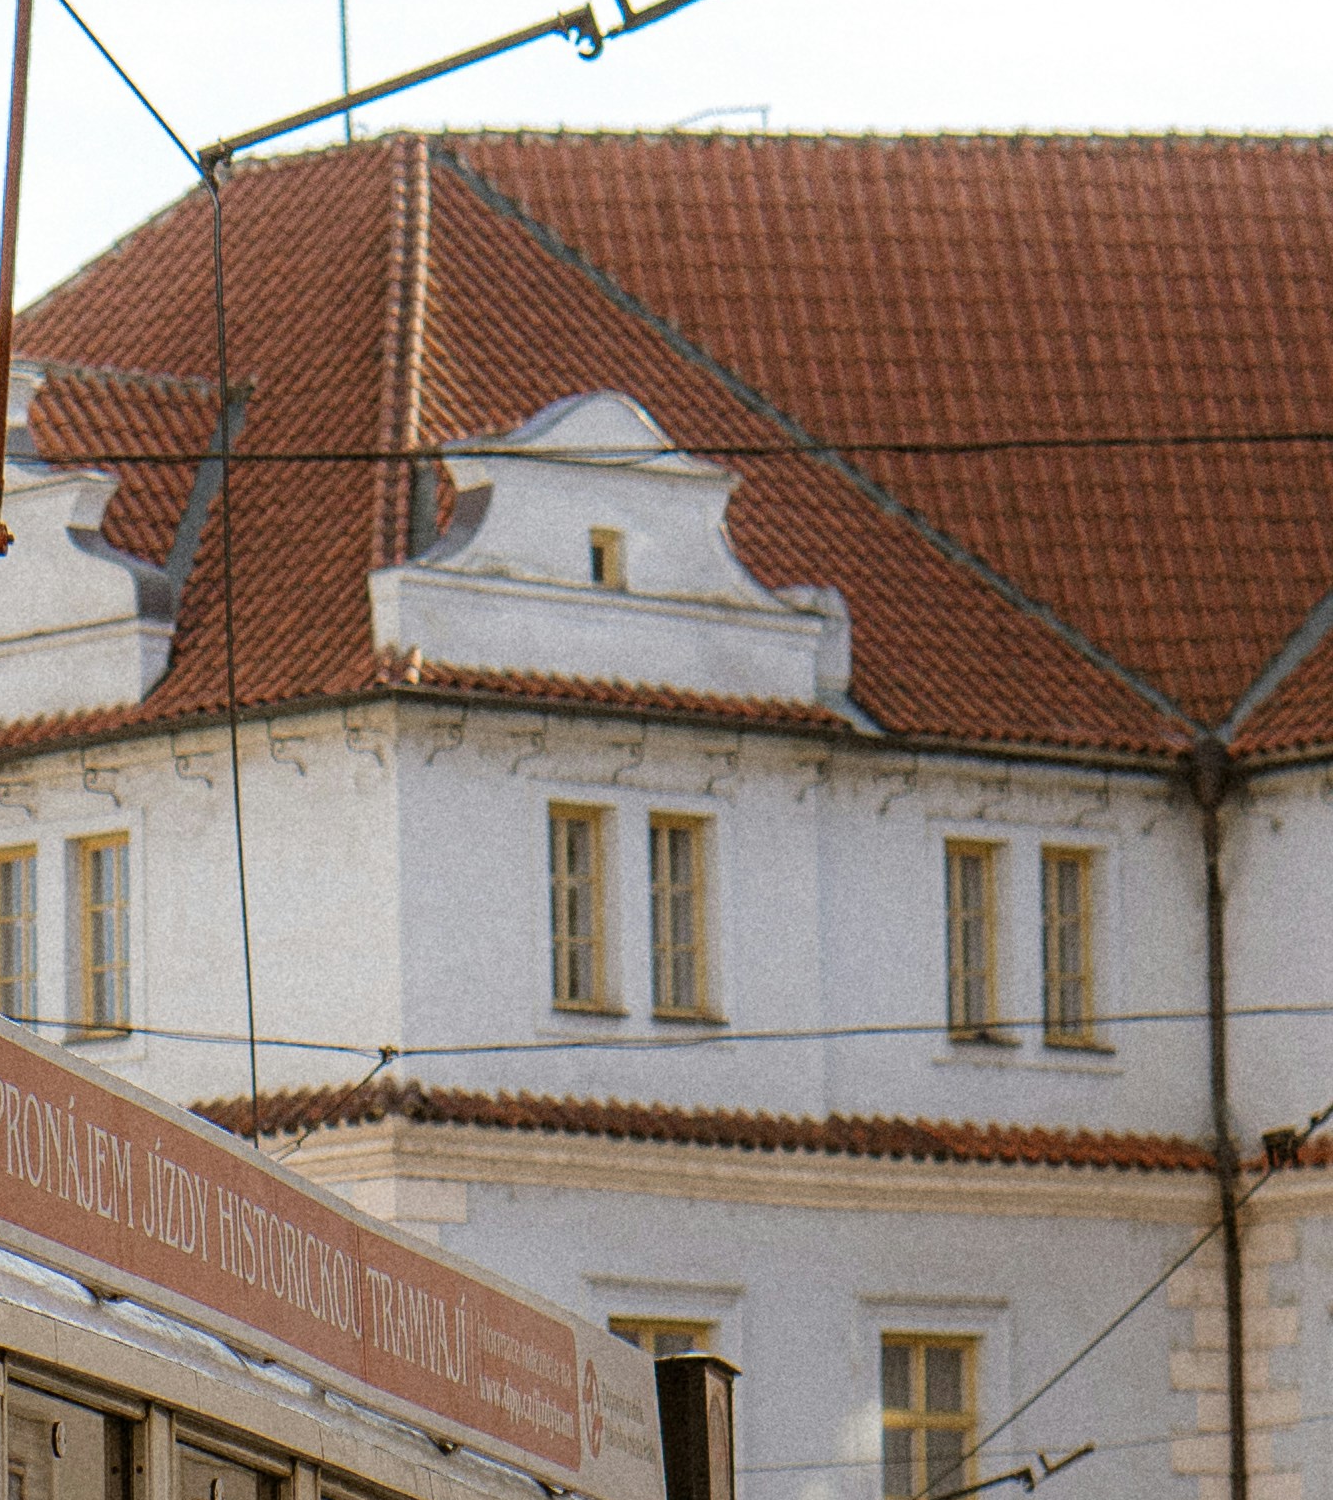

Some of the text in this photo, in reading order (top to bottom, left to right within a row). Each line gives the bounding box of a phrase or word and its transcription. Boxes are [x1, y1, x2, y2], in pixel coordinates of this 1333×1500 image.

[142, 1135, 210, 1263] JÍZDY
[216, 1185, 363, 1340] HISTORICKOU
[365, 1264, 468, 1386] TRAMVAJÍ
